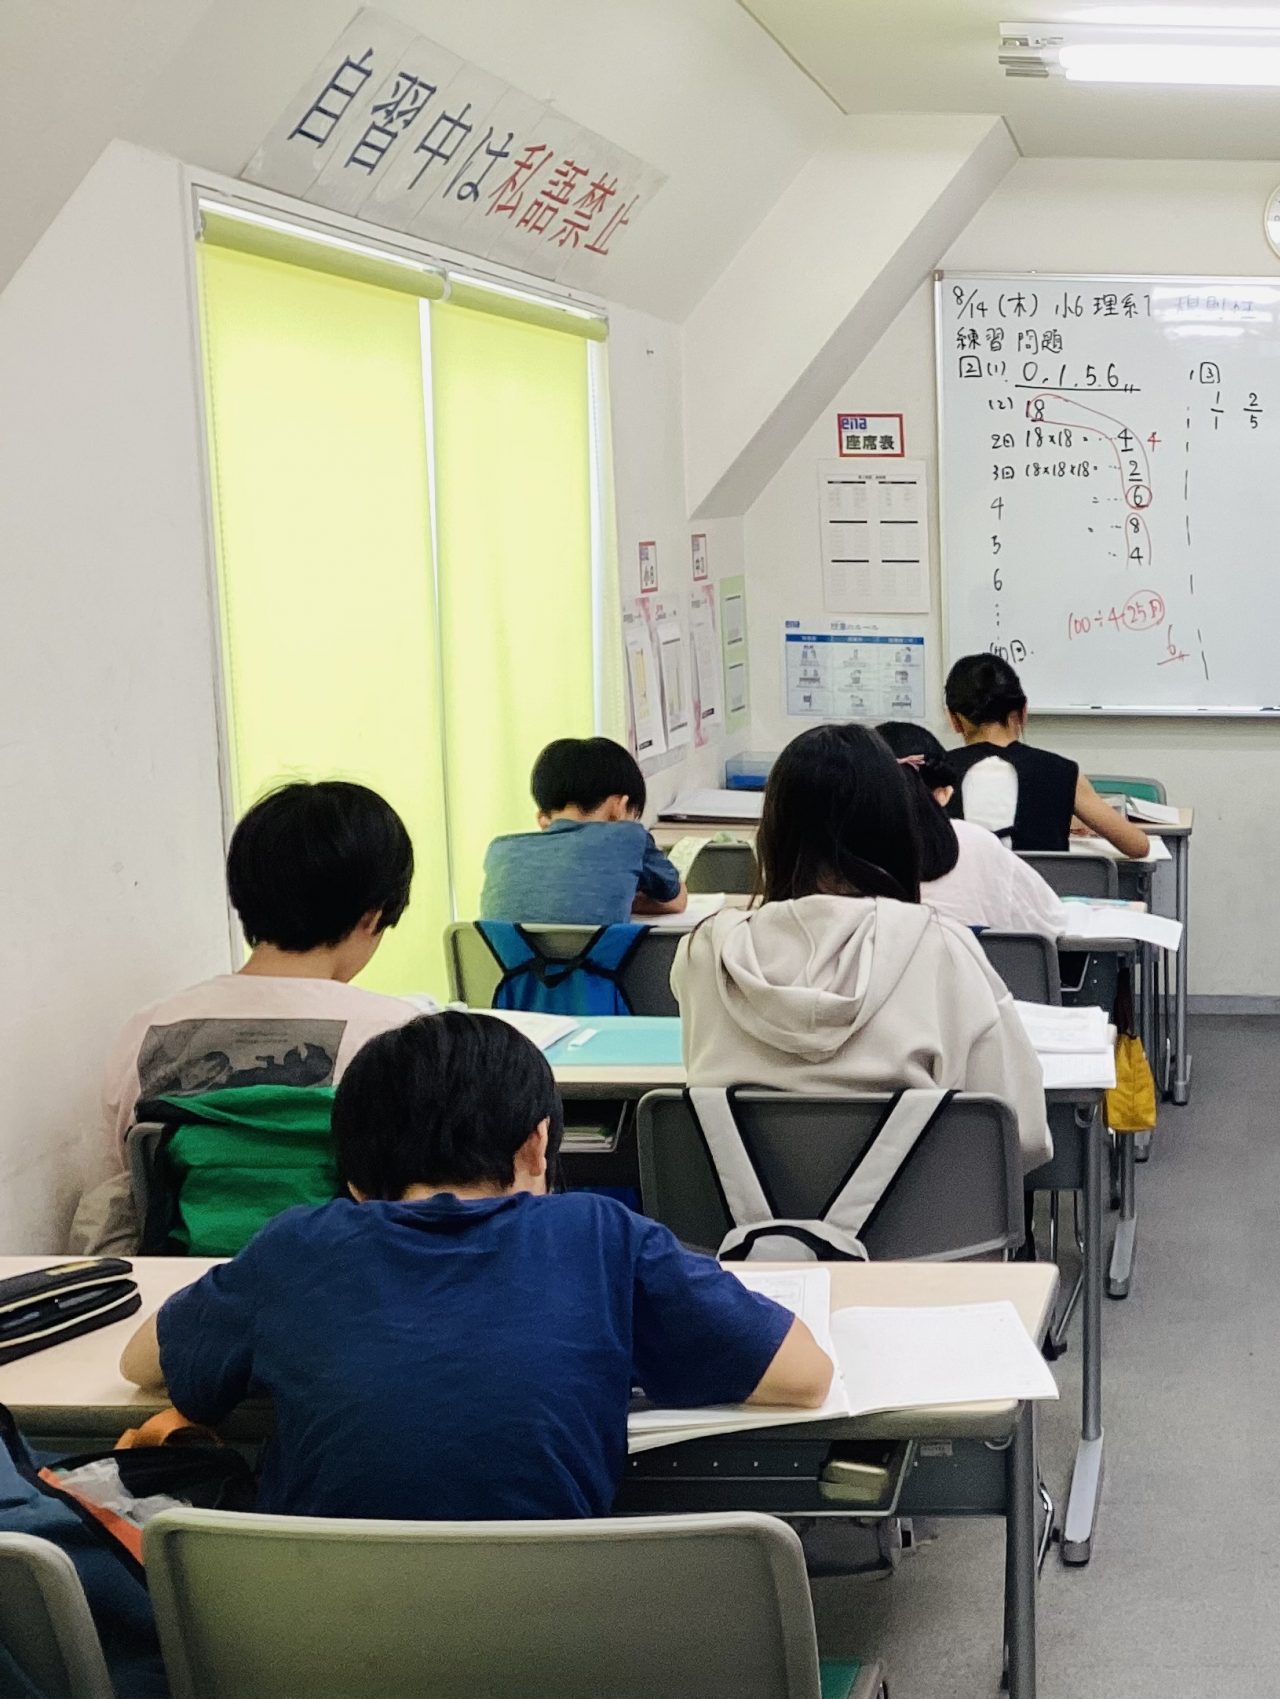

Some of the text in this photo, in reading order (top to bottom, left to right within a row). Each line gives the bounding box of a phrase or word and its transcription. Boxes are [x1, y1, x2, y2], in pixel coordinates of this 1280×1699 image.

[287, 47, 641, 256] 自習中は私語禁止
[1248, 392, 1260, 407] 2
[841, 417, 868, 430] ena
[1249, 414, 1259, 430] 5
[845, 434, 896, 451] 座席表
[989, 486, 1144, 520] 4 6
[1129, 517, 1140, 533] 8
[993, 547, 1144, 591] 6 4
